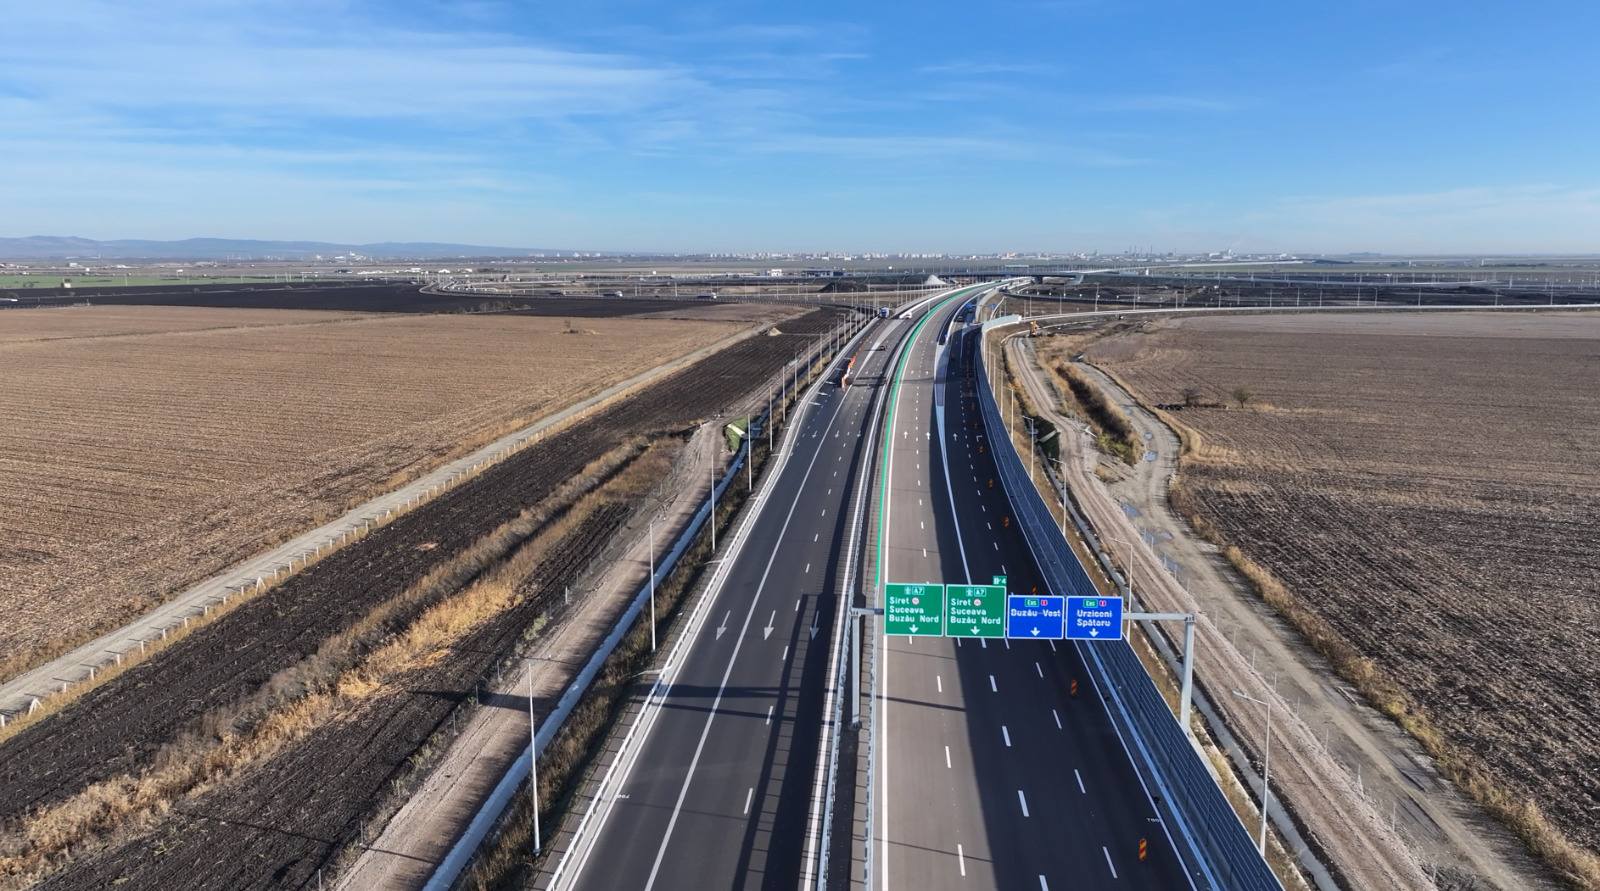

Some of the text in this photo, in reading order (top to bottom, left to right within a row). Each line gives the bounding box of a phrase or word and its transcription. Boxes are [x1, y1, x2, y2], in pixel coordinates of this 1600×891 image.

[889, 596, 910, 605] Siret
[950, 598, 972, 606] Siret
[889, 605, 925, 614] Suceava
[950, 607, 987, 616] Suceava
[1076, 609, 1113, 618] Urziceni
[889, 614, 940, 623] Buzău Nord
[950, 616, 1001, 625] Buzău Nord
[1077, 618, 1111, 628] Spătaru
